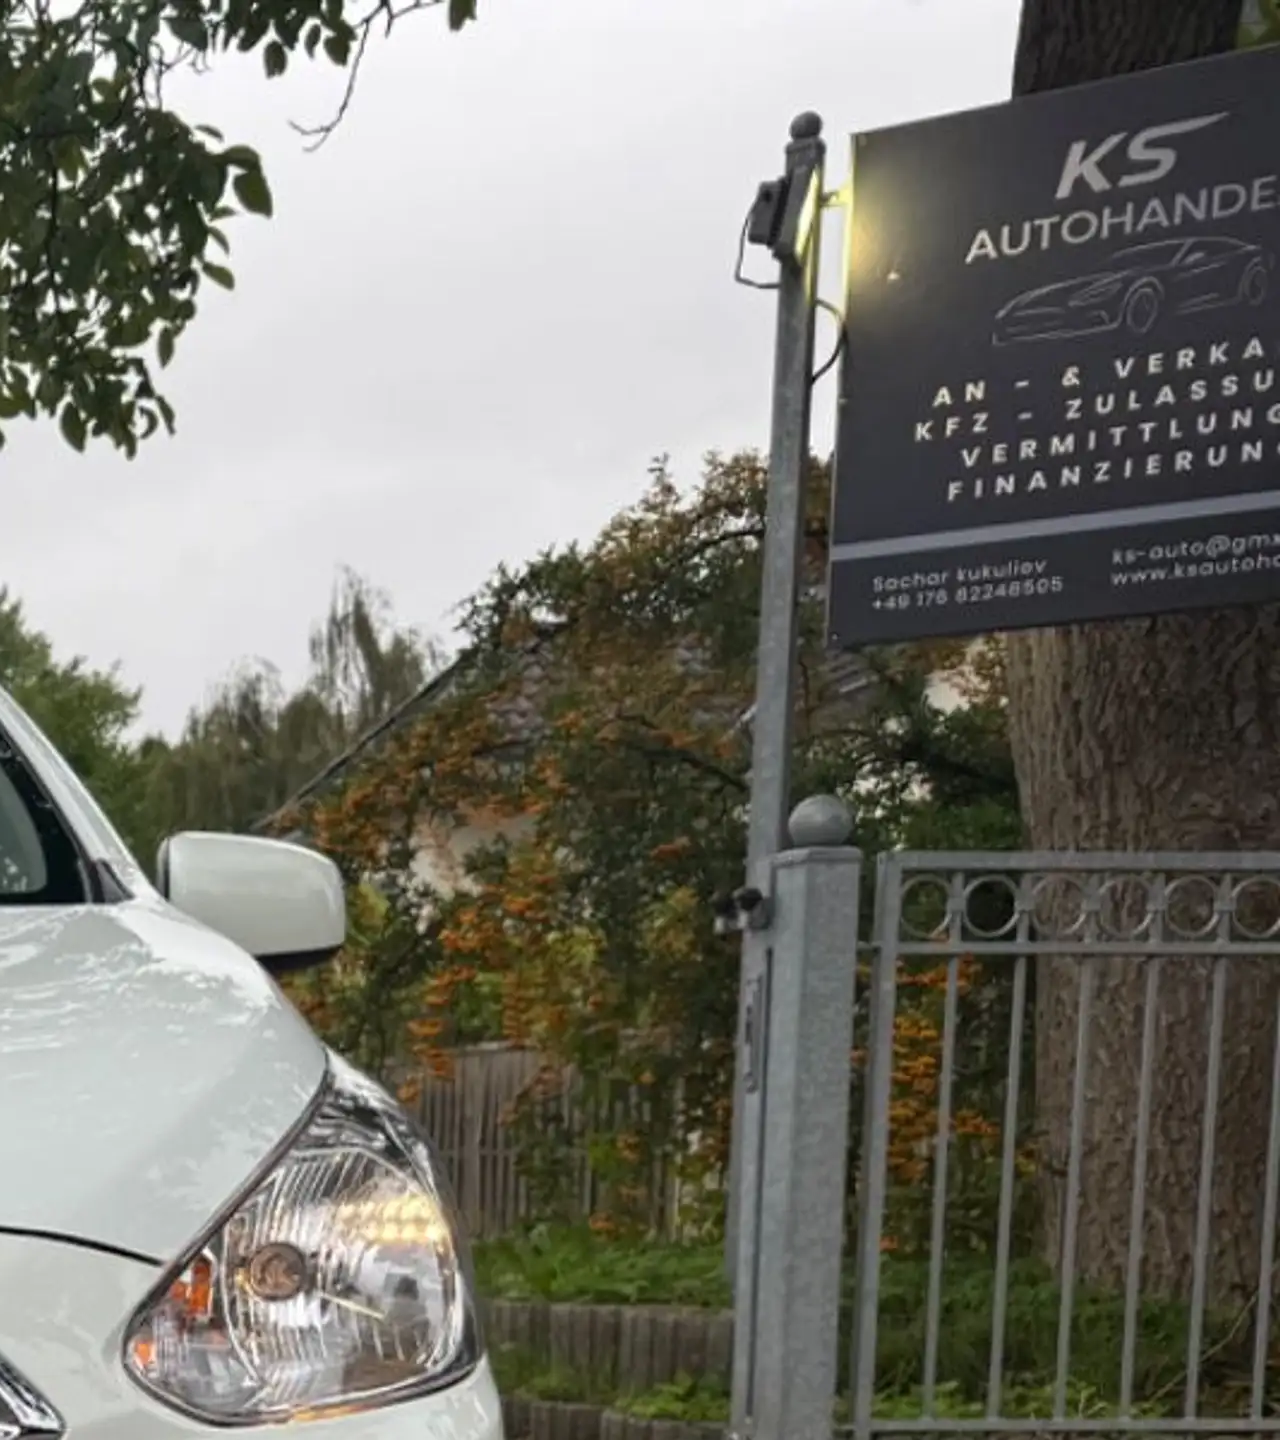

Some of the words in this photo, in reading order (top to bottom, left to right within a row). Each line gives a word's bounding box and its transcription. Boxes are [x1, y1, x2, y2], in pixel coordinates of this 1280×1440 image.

[1054, 111, 1230, 200] KS
[964, 175, 1280, 265] AUTOHANDE
[931, 379, 987, 408] AN
[1060, 365, 1081, 388] &
[1113, 336, 1280, 380] VERKA
[914, 411, 989, 443] KFZ
[961, 402, 1280, 469] VERMITTLUNG
[947, 438, 1280, 502] FINANZIERUN
